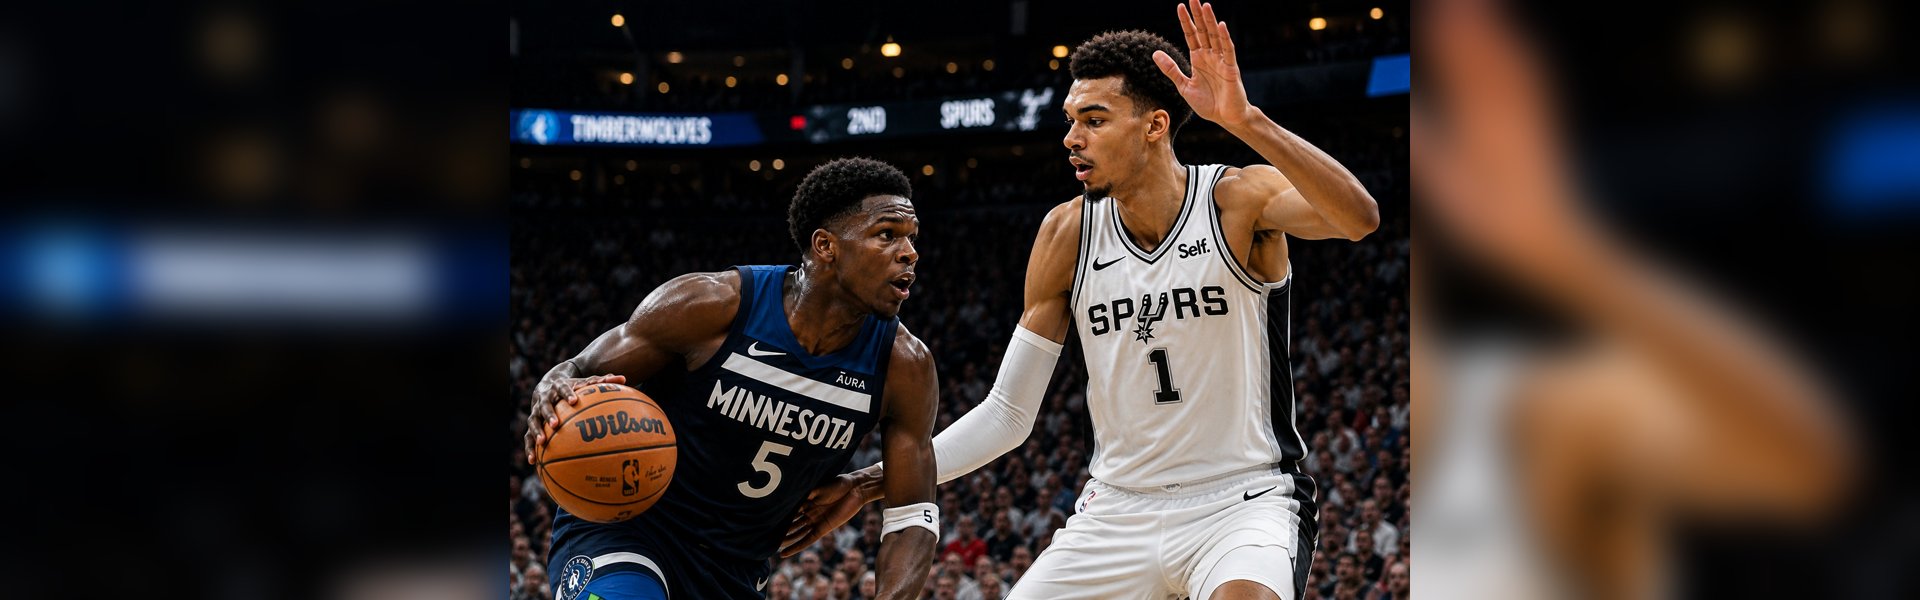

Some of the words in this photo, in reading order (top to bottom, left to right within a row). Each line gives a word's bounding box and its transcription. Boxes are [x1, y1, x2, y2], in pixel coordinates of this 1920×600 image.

[570, 114, 712, 144] TIMBERWOLVES
[847, 106, 886, 134] 2ND
[940, 98, 996, 129] SPURS
[1178, 238, 1211, 259] Self.
[1088, 286, 1228, 344] SPURS
[1147, 347, 1183, 405] 1
[575, 411, 666, 442] Wilson
[707, 379, 855, 450] MINNESOTA
[737, 440, 793, 498] 5
[923, 509, 933, 523] 5
